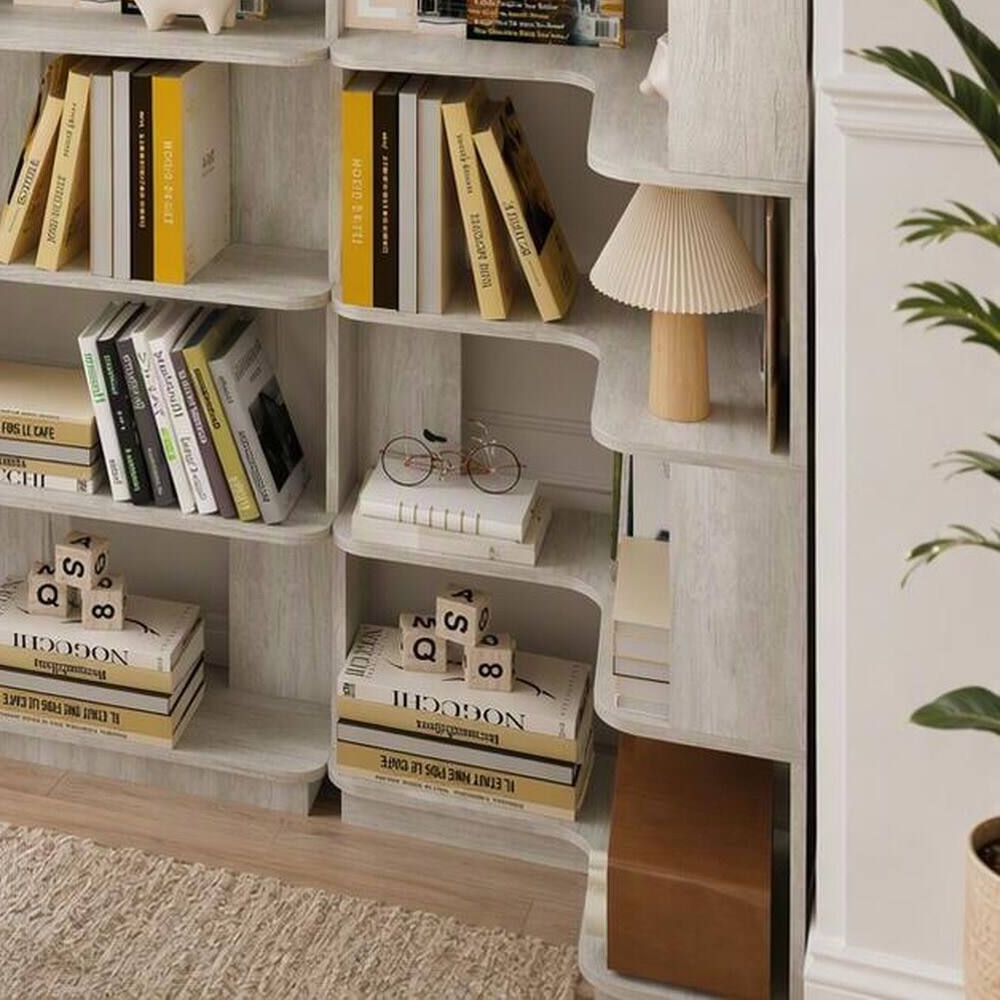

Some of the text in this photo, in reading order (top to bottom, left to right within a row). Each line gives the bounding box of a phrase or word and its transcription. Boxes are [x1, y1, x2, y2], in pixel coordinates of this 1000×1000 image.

[62, 557, 84, 578] S
[37, 584, 59, 607] Q
[92, 604, 115, 619] 8
[444, 611, 468, 634] S
[413, 637, 436, 663] Q
[479, 663, 503, 678] 8
[393, 690, 525, 730] NOGUCHI
